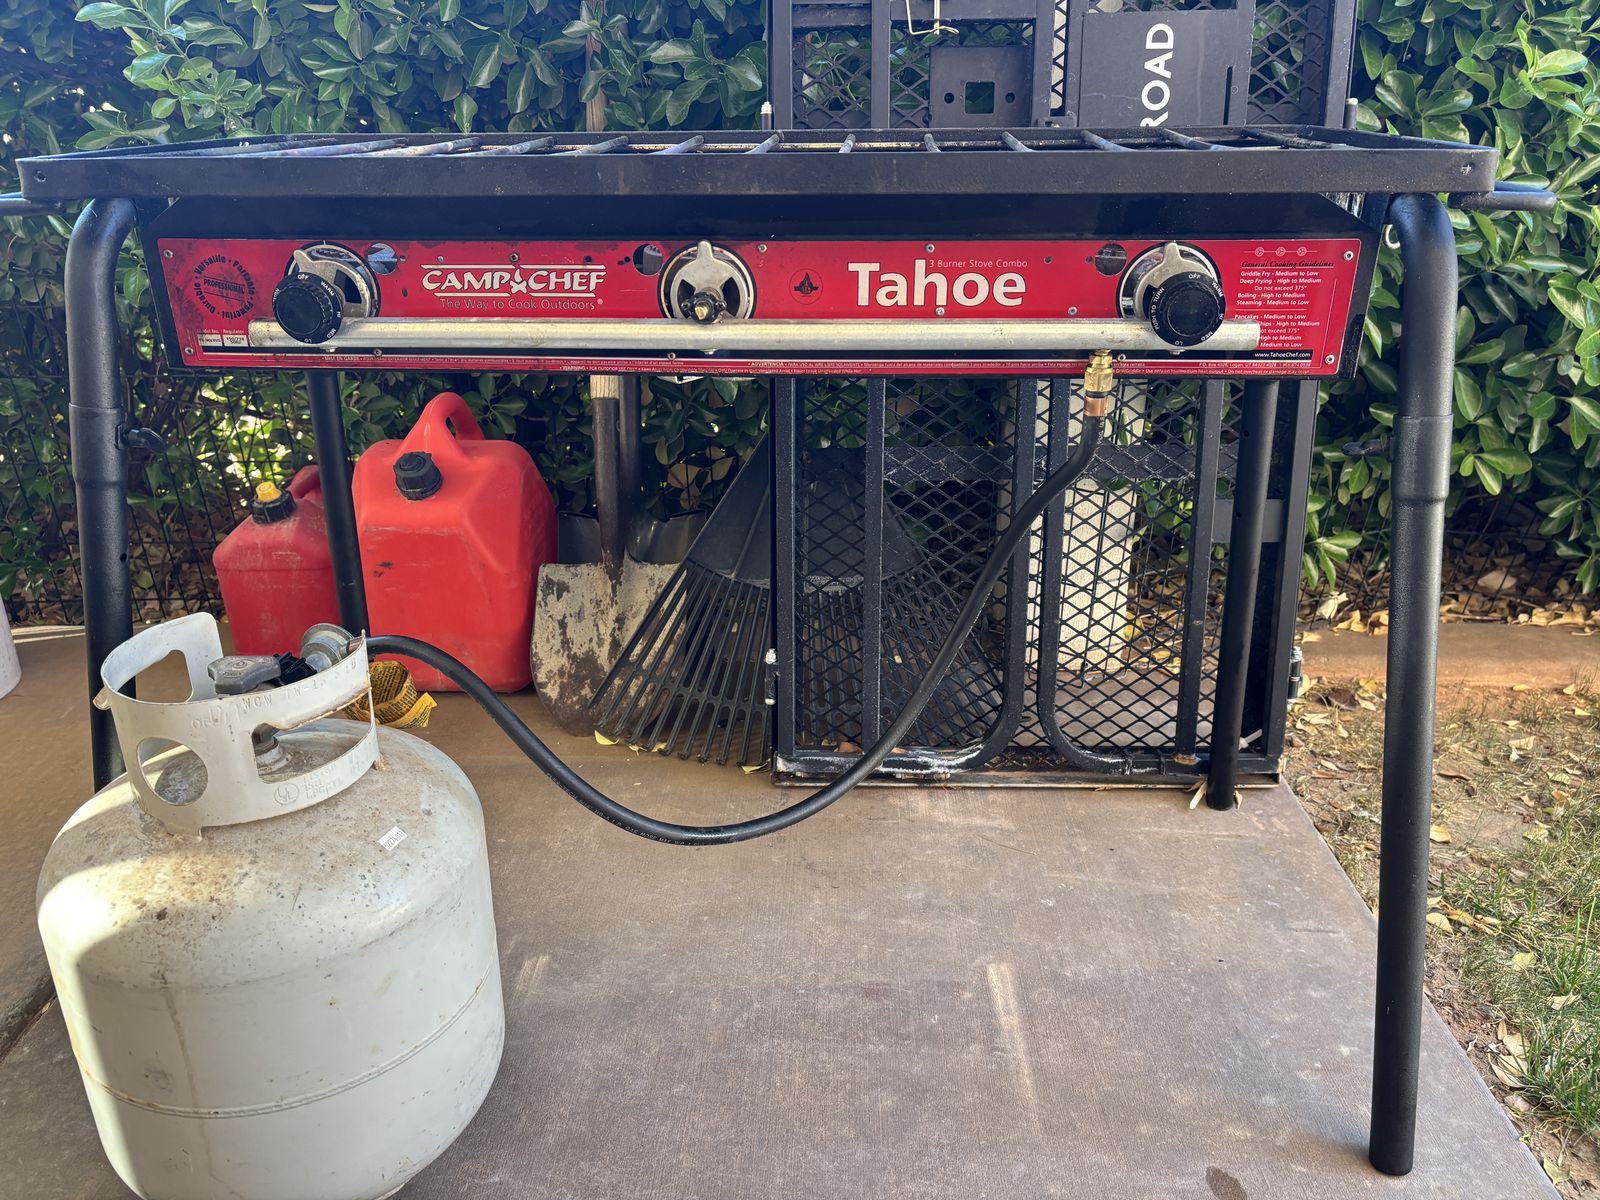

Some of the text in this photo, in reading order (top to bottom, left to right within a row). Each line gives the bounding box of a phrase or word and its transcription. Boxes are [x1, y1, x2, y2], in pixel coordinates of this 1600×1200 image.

[194, 255, 226, 274] Versatile
[929, 260, 1028, 268] 3 Burner Stove Combo
[1270, 260, 1297, 269] Cooking
[232, 260, 255, 295] Portable
[421, 270, 606, 291] CAMP CHEF
[848, 258, 1026, 307] Tahoe
[204, 278, 244, 294] PROFESSIONAL
[320, 280, 335, 296] WARM
[1211, 281, 1224, 297] WARM
[194, 282, 216, 314] Durable
[440, 299, 596, 311] The Way to Cook Outdoors
[222, 300, 254, 319] Powerful
[1151, 287, 1165, 330] PUSH TO TURN
[326, 328, 337, 339] MED
[1201, 331, 1213, 342] MED
[1254, 351, 1311, 359] www.TahoeChef.com
